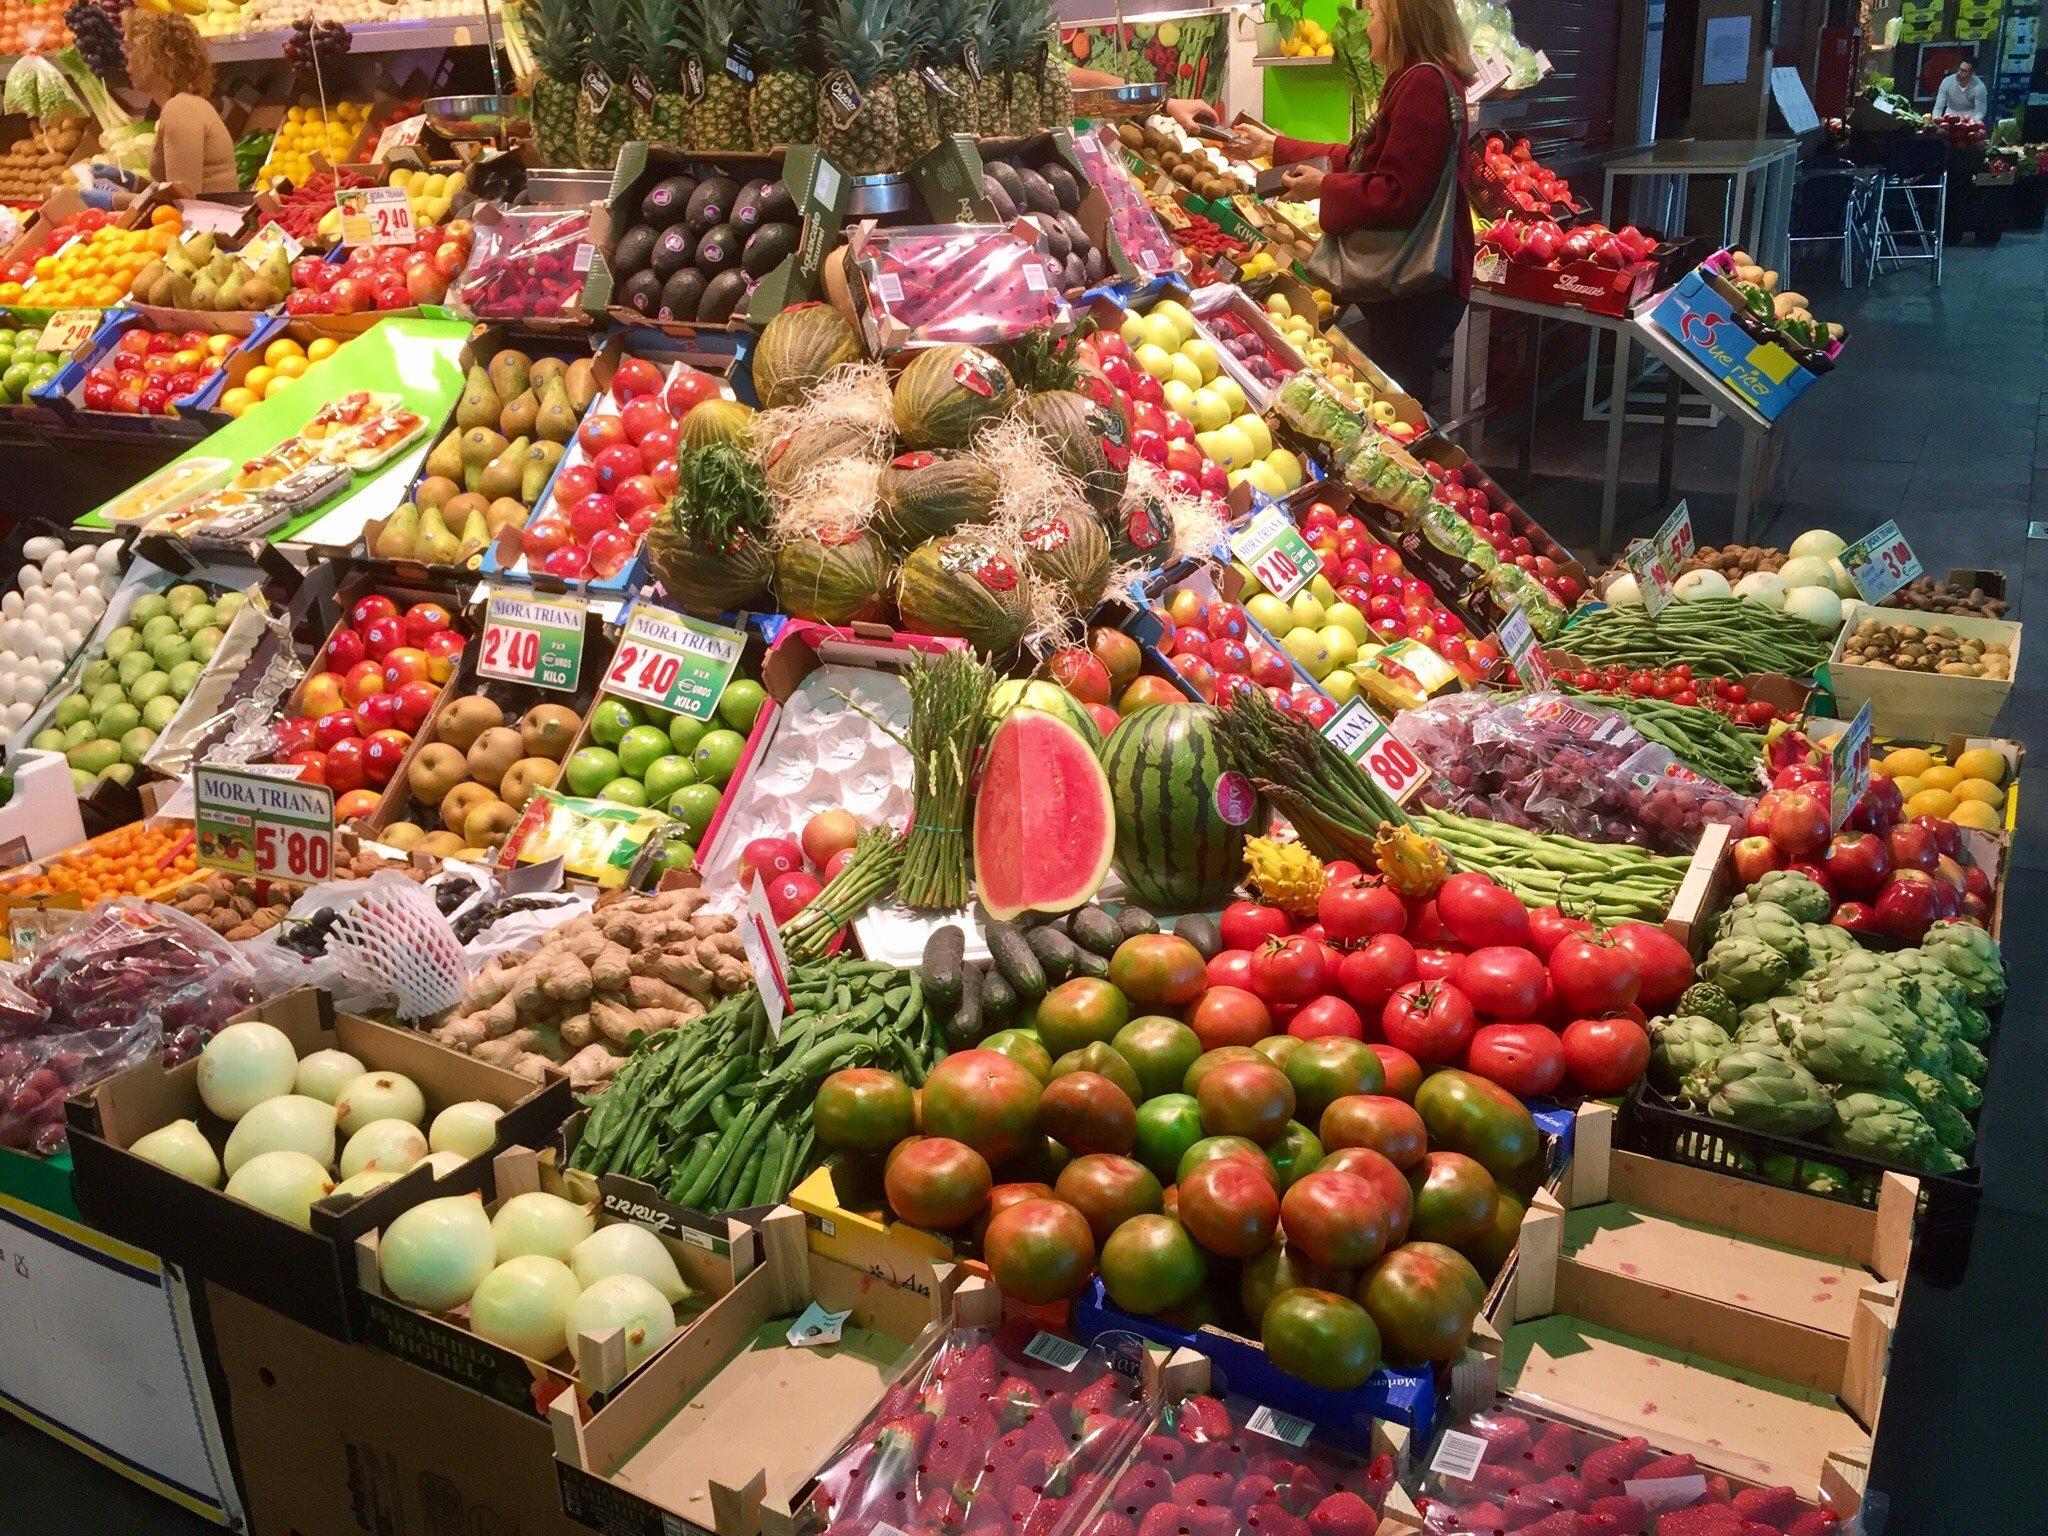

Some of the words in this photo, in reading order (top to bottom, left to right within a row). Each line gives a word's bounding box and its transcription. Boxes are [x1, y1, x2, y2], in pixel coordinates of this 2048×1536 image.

[831, 80, 856, 111] Orsero
[800, 211, 822, 279] Aguacate
[494, 601, 530, 620] MORA
[534, 606, 580, 628] TRIANA
[484, 628, 539, 671] 2'40
[636, 618, 677, 643] MORA
[679, 631, 734, 660] TRIANA
[543, 670, 566, 685] KILO
[610, 645, 680, 695] 2'40
[674, 695, 702, 711] KILO
[204, 778, 255, 804] MORA
[259, 787, 326, 815] TRIANA
[256, 826, 329, 879] 5'80
